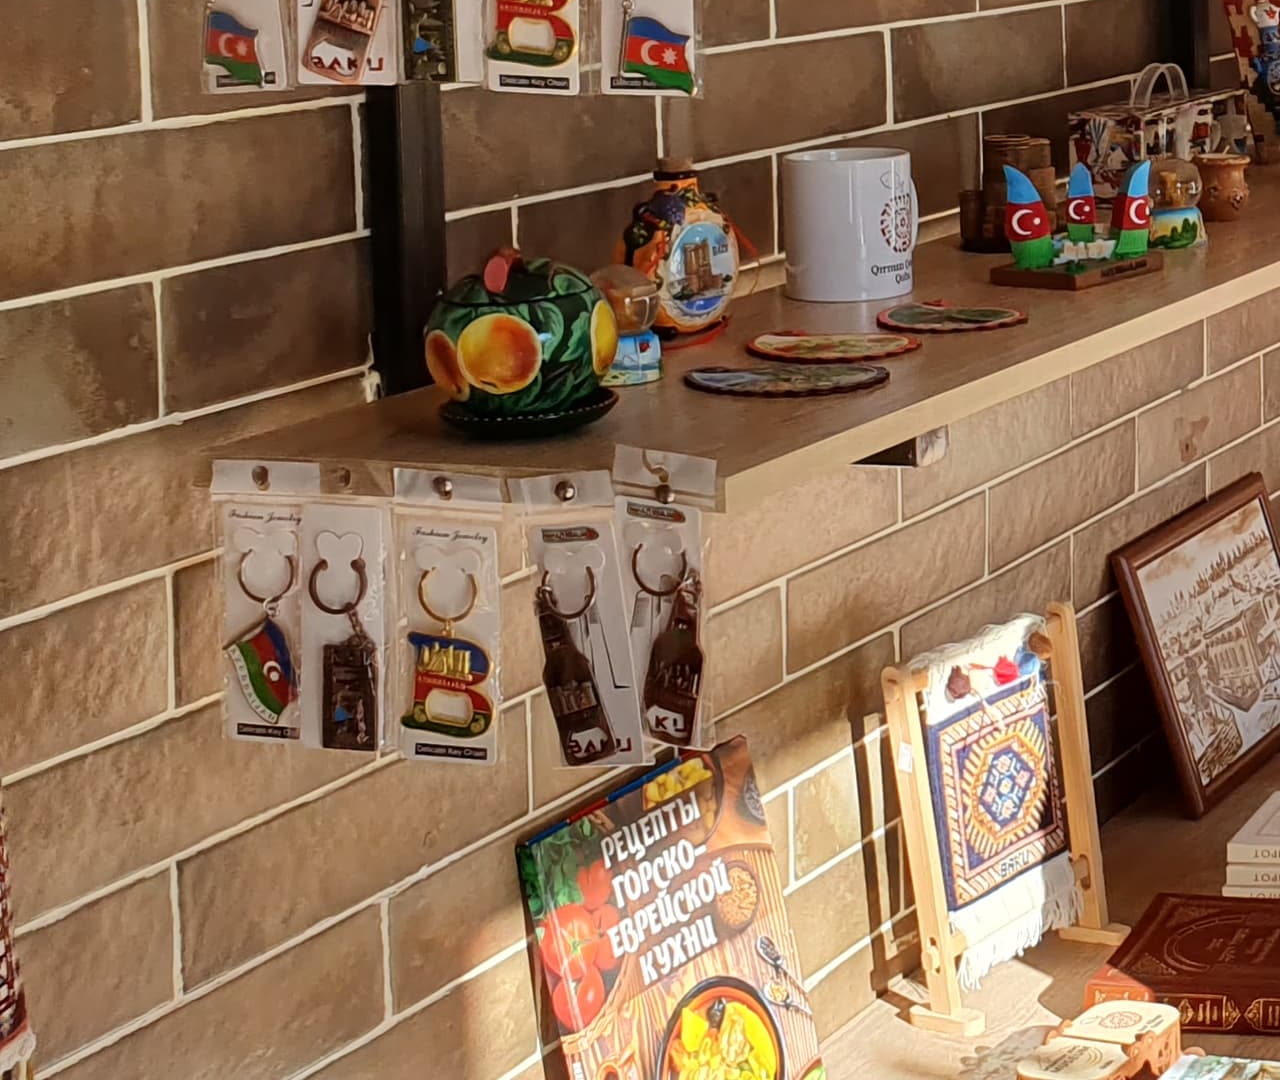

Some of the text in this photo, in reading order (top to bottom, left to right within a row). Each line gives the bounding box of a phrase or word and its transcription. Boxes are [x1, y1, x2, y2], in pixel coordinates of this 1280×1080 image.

[600, 790, 702, 870] РЕЦЕПТЫ
[606, 858, 733, 958] ЕВРЕЙСКОЙ
[611, 839, 707, 909] ГОРСКО-
[639, 916, 718, 985] КУХНИ
